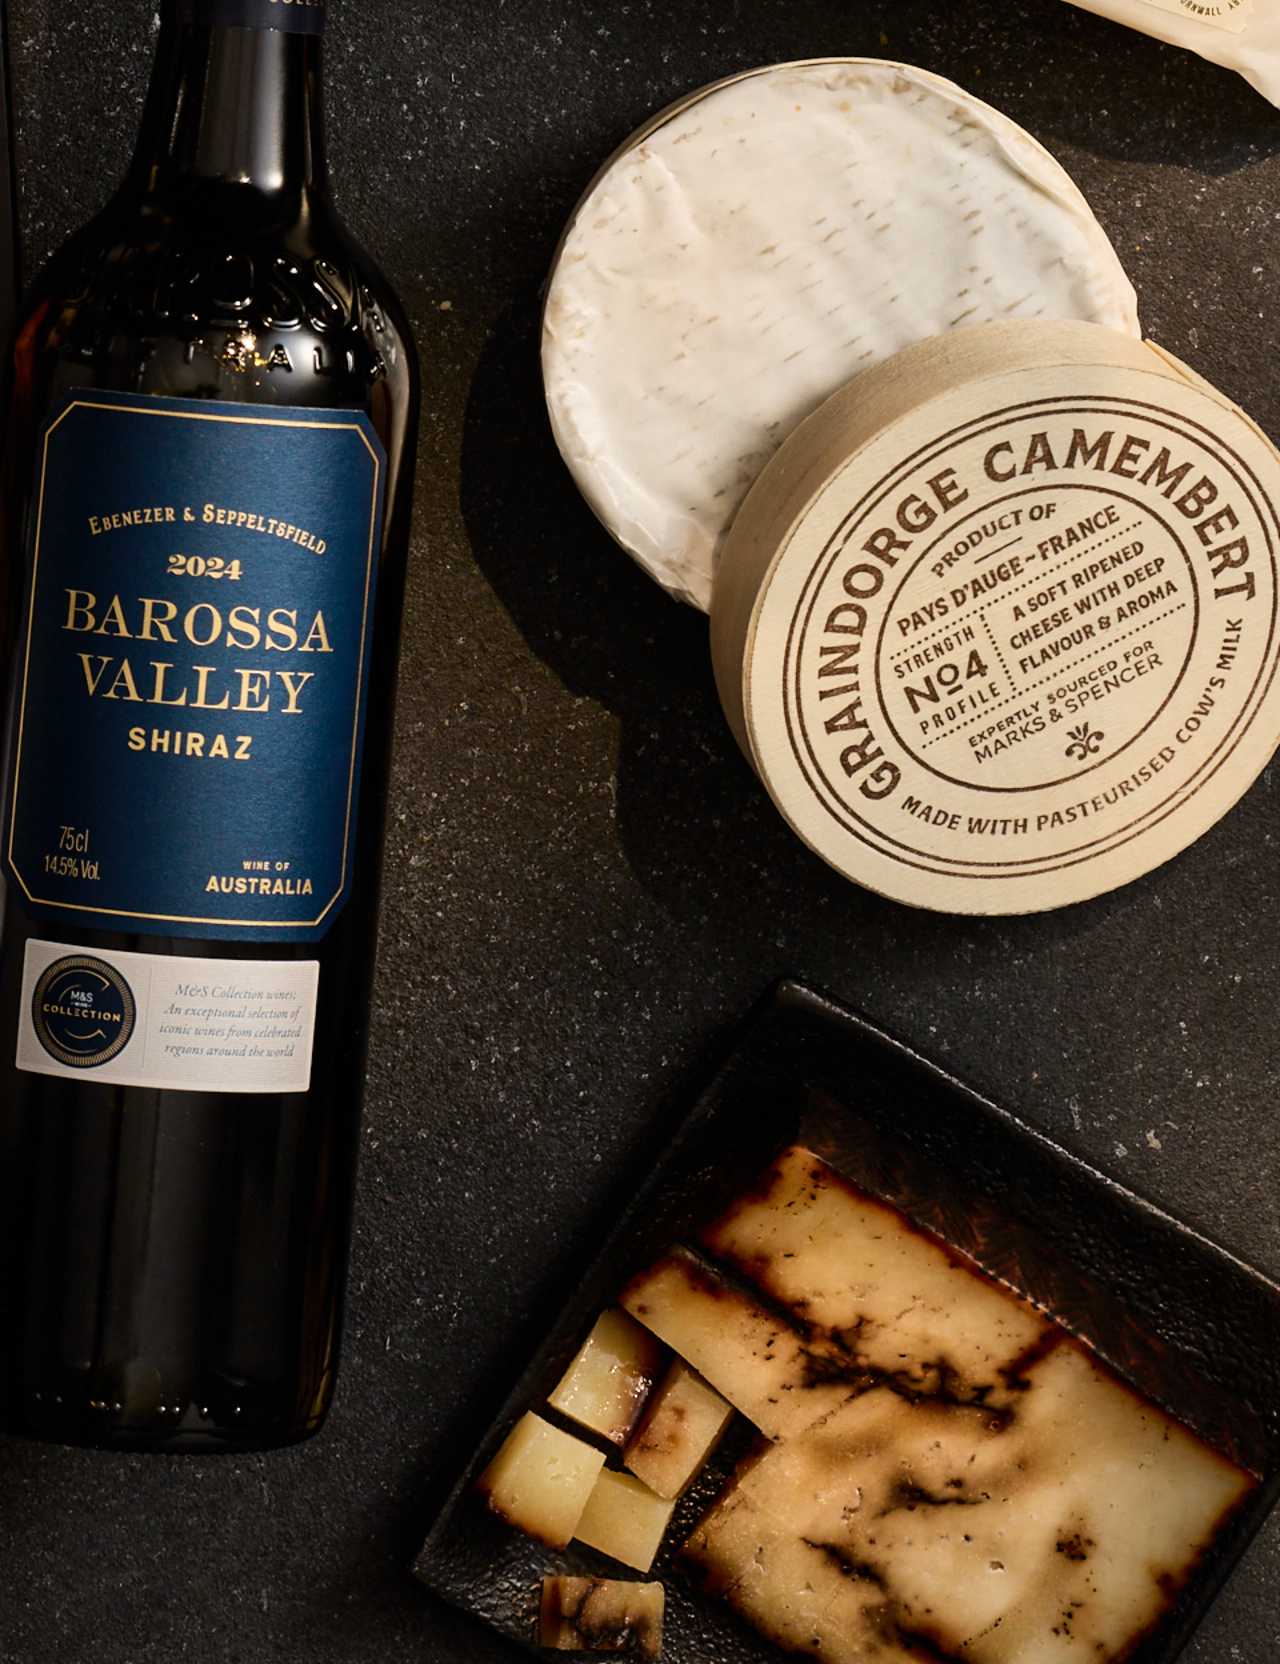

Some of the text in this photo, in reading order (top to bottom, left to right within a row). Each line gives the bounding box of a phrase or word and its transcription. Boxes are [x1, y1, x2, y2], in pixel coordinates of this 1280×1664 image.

[184, 507, 195, 522] &
[931, 503, 1056, 578] PRODUCT OF
[167, 553, 243, 580] 2024
[897, 505, 1120, 637] PAYS D'AUGE FRANCE
[1012, 540, 1145, 622] A SOFT RIPENED
[62, 588, 334, 652] BAROSSA
[818, 428, 1256, 801] GRAINDORGE CAMEMBERT
[1010, 557, 1165, 650] CHEESE WITH DEEP
[1019, 580, 1178, 674] FLAVOUR & AROMA
[894, 626, 975, 679] STRENGTH
[76, 653, 314, 713] VALLEY
[920, 681, 1001, 735] PROFILE
[969, 640, 1154, 747] EXPERTLY SOURCED FOR
[973, 652, 1163, 764] MARKS & SPENCER
[128, 727, 252, 760] SHIRAZ
[901, 617, 1244, 835] MADE WITH PASTEURISED COW'S MILK
[44, 855, 100, 880] 14.5% Vol.
[58, 826, 89, 853] 75cl
[242, 860, 290, 871] WINE OF
[206, 876, 312, 895] AUSTRALIA
[43, 1003, 120, 1022] COLLECTION
[71, 990, 93, 1002] M&S
